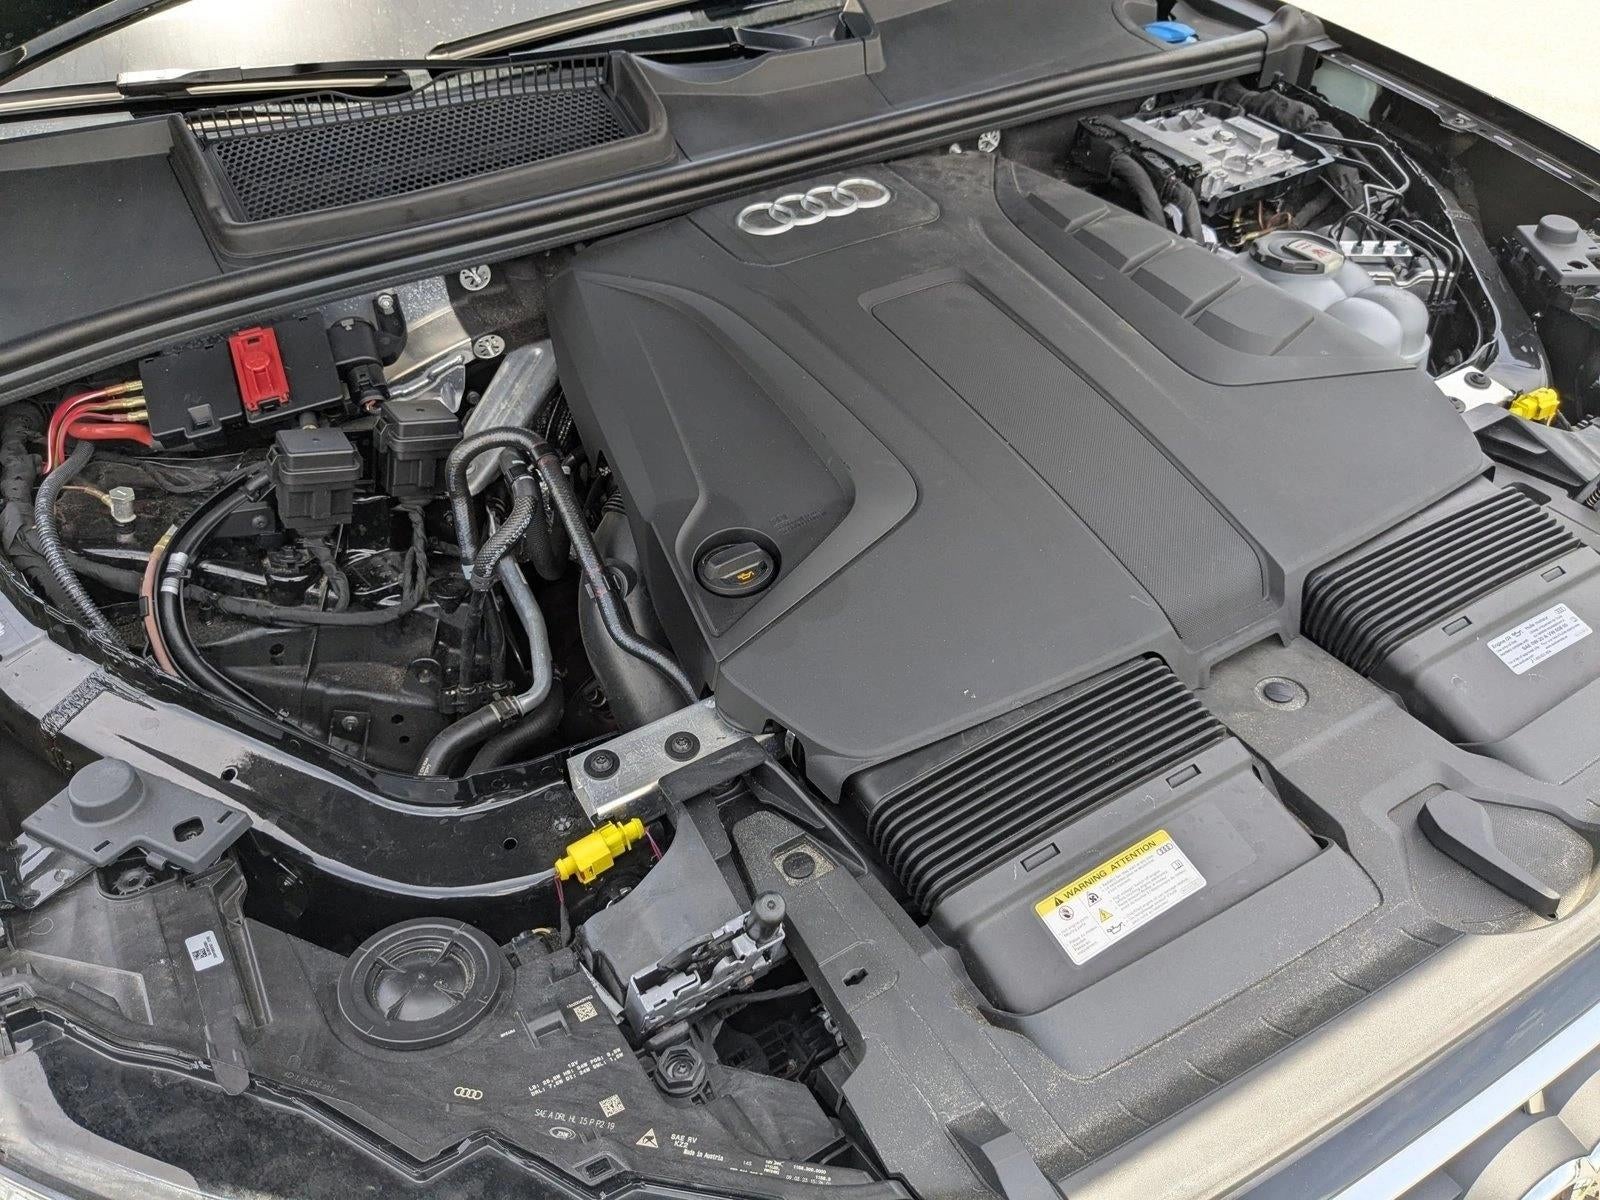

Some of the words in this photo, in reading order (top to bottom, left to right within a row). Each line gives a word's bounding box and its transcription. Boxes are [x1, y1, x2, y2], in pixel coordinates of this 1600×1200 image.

[1064, 870, 1107, 899] WARNING
[1110, 840, 1156, 872] ATTENTION
[534, 1108, 546, 1118] SAE
[555, 1113, 566, 1122] DRL
[596, 1120, 605, 1128] P2
[670, 1133, 685, 1142] SAE
[674, 1140, 688, 1149] KZ2
[703, 1151, 724, 1161] Austria
